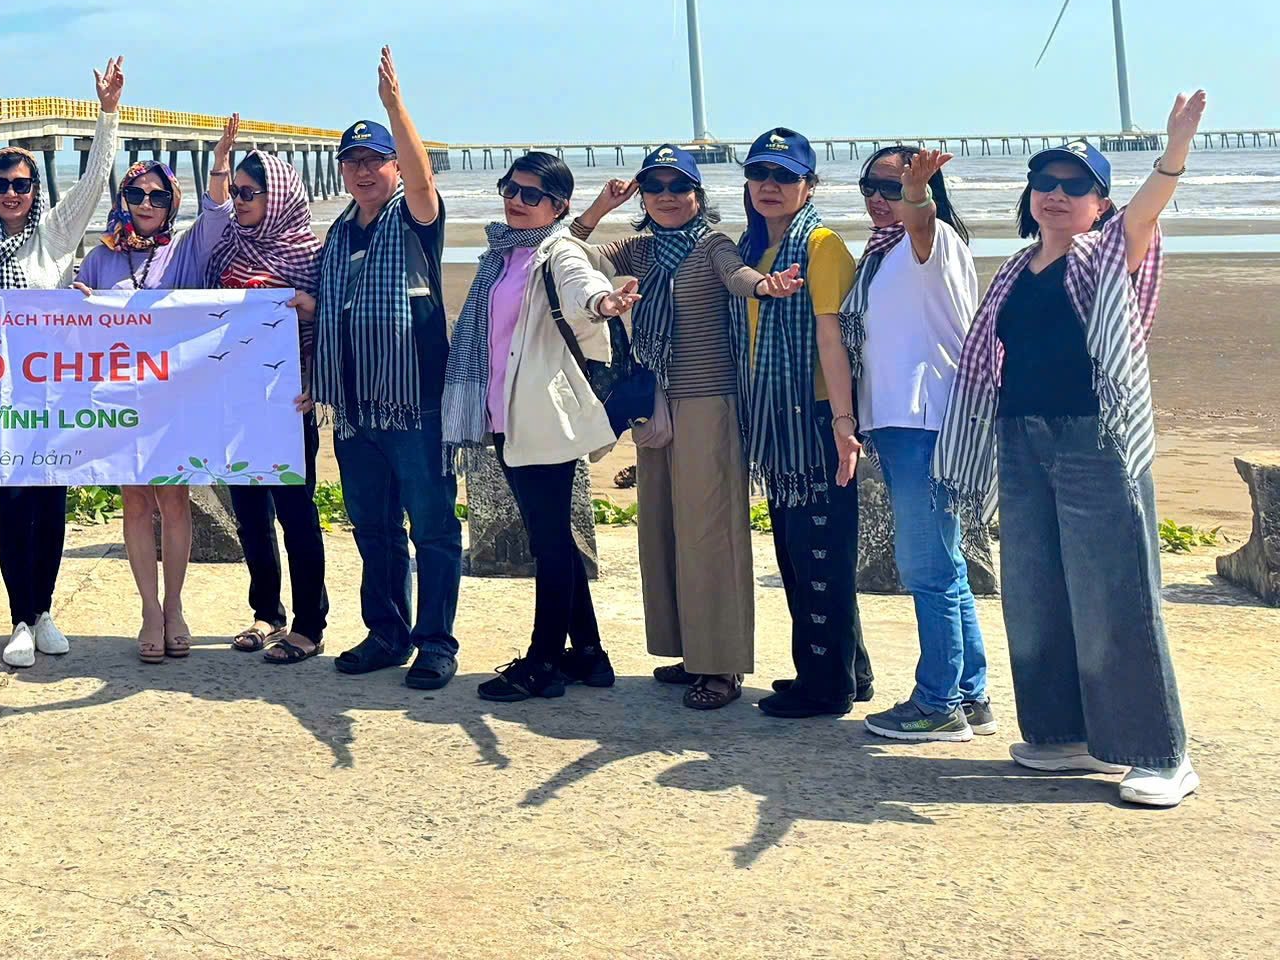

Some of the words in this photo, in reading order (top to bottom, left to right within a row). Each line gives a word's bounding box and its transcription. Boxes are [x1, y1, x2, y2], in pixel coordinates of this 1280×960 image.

[42, 314, 92, 326] THAM
[99, 313, 152, 328] QUAN
[22, 342, 169, 383] CHIÊN
[58, 408, 139, 428] LONG
